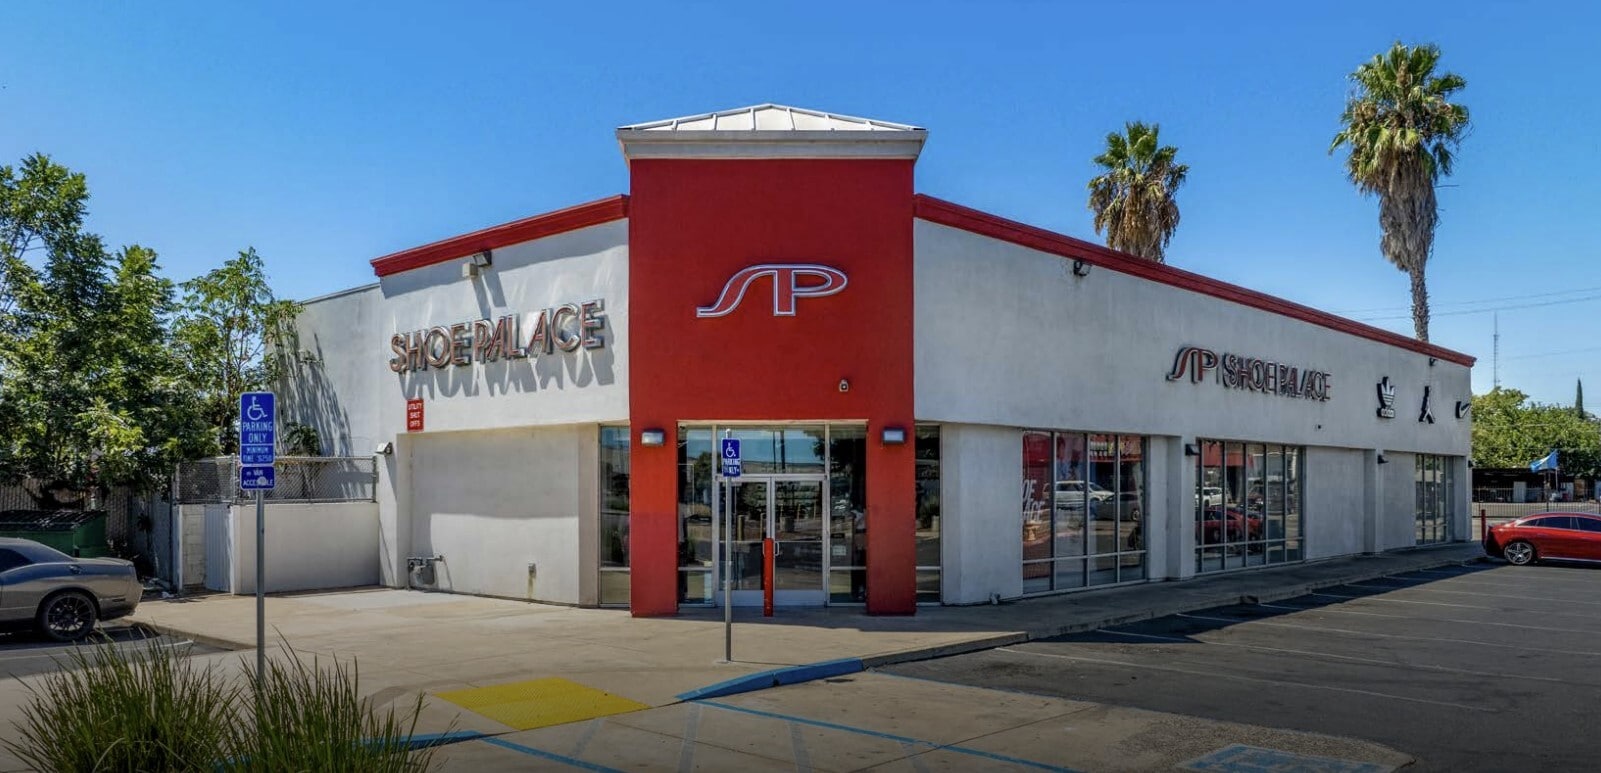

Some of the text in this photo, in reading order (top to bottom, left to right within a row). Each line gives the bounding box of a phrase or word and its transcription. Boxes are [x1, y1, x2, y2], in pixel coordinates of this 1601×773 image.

[390, 298, 605, 374] SHOE PALACE
[1222, 353, 1277, 396] SHOE
[1279, 363, 1332, 402] PALACE
[243, 421, 273, 432] PARKING
[248, 433, 268, 443] ONLY
[246, 446, 269, 454] MINIMUM
[243, 454, 254, 462] FINE
[722, 458, 740, 466] PARKING
[723, 466, 738, 474] ONLY
[242, 479, 274, 487] ACCELE
